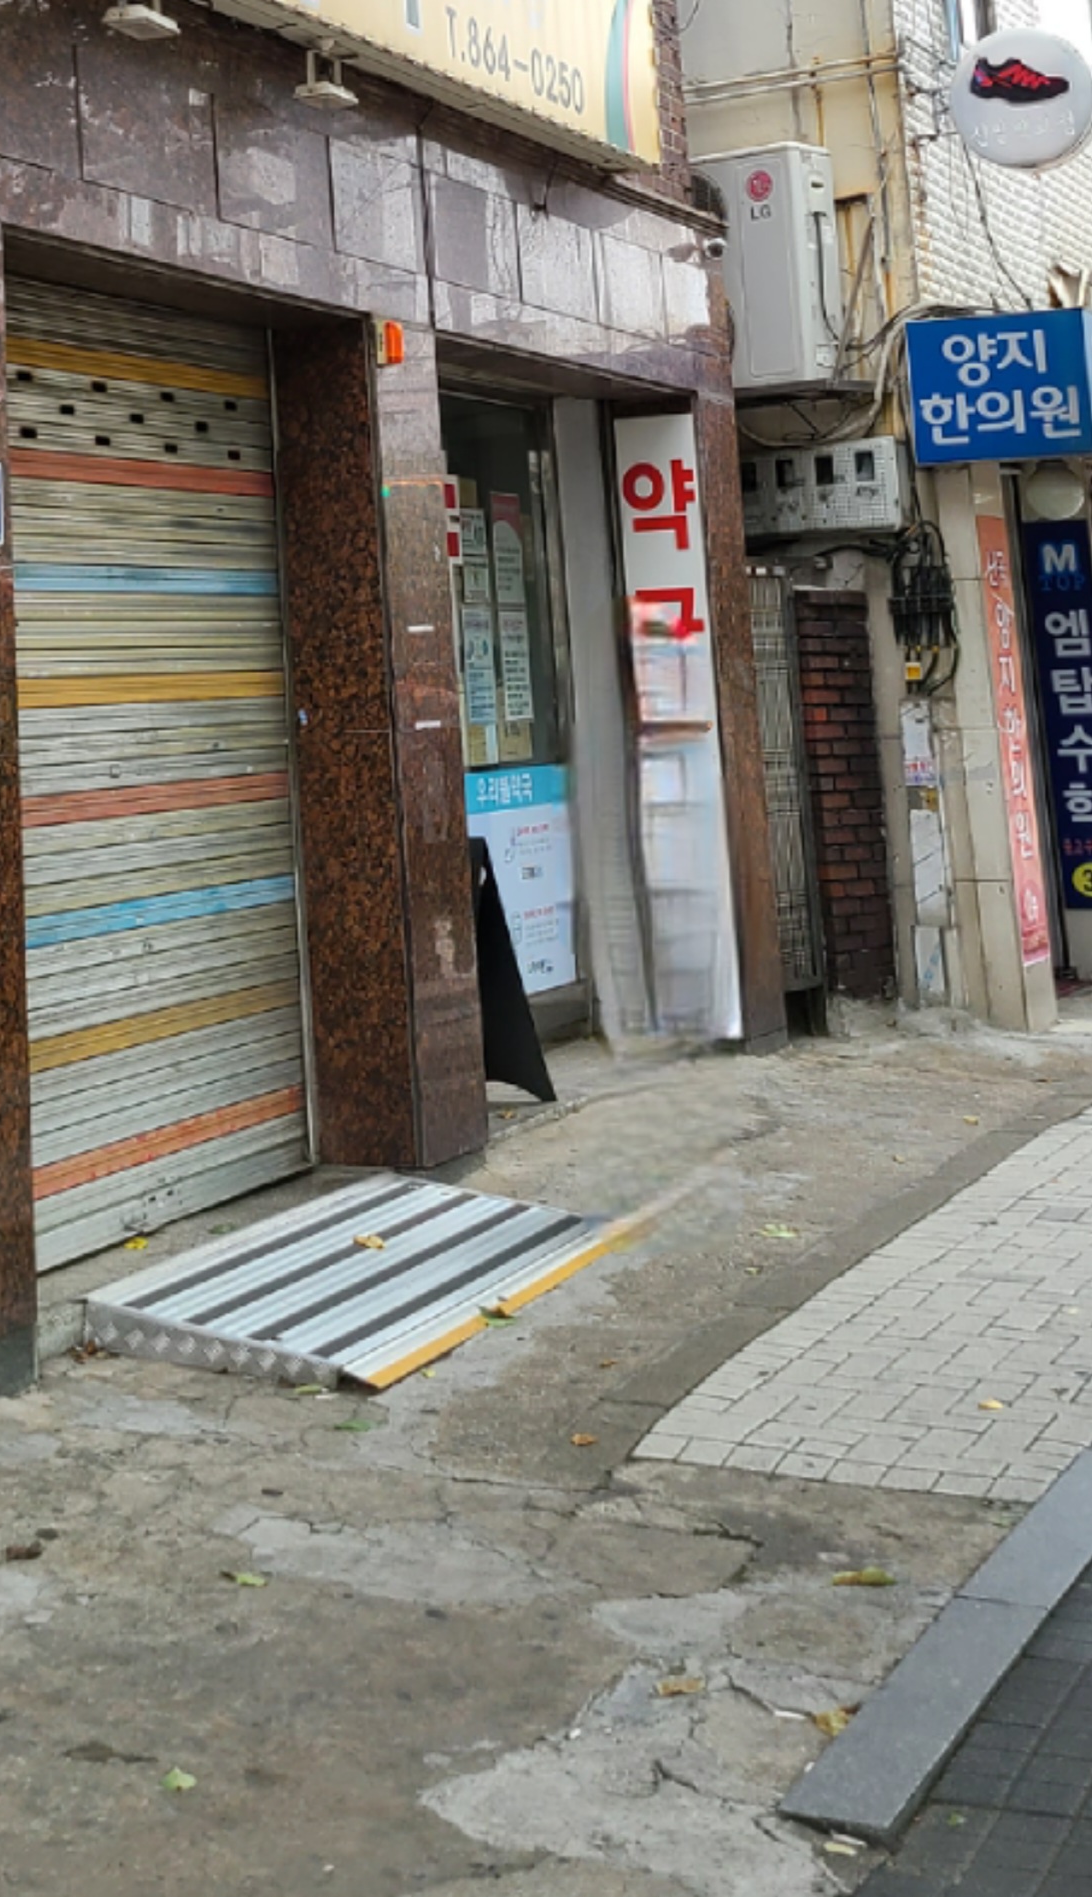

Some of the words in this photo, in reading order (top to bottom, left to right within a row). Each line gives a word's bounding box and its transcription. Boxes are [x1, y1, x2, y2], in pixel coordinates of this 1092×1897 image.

[444, 4, 586, 117] T.864-0250
[750, 204, 772, 222] LG
[941, 328, 1048, 389] 양지
[919, 384, 1082, 446] 한의원
[1041, 542, 1078, 574] M
[476, 772, 533, 808] 우리들약국
